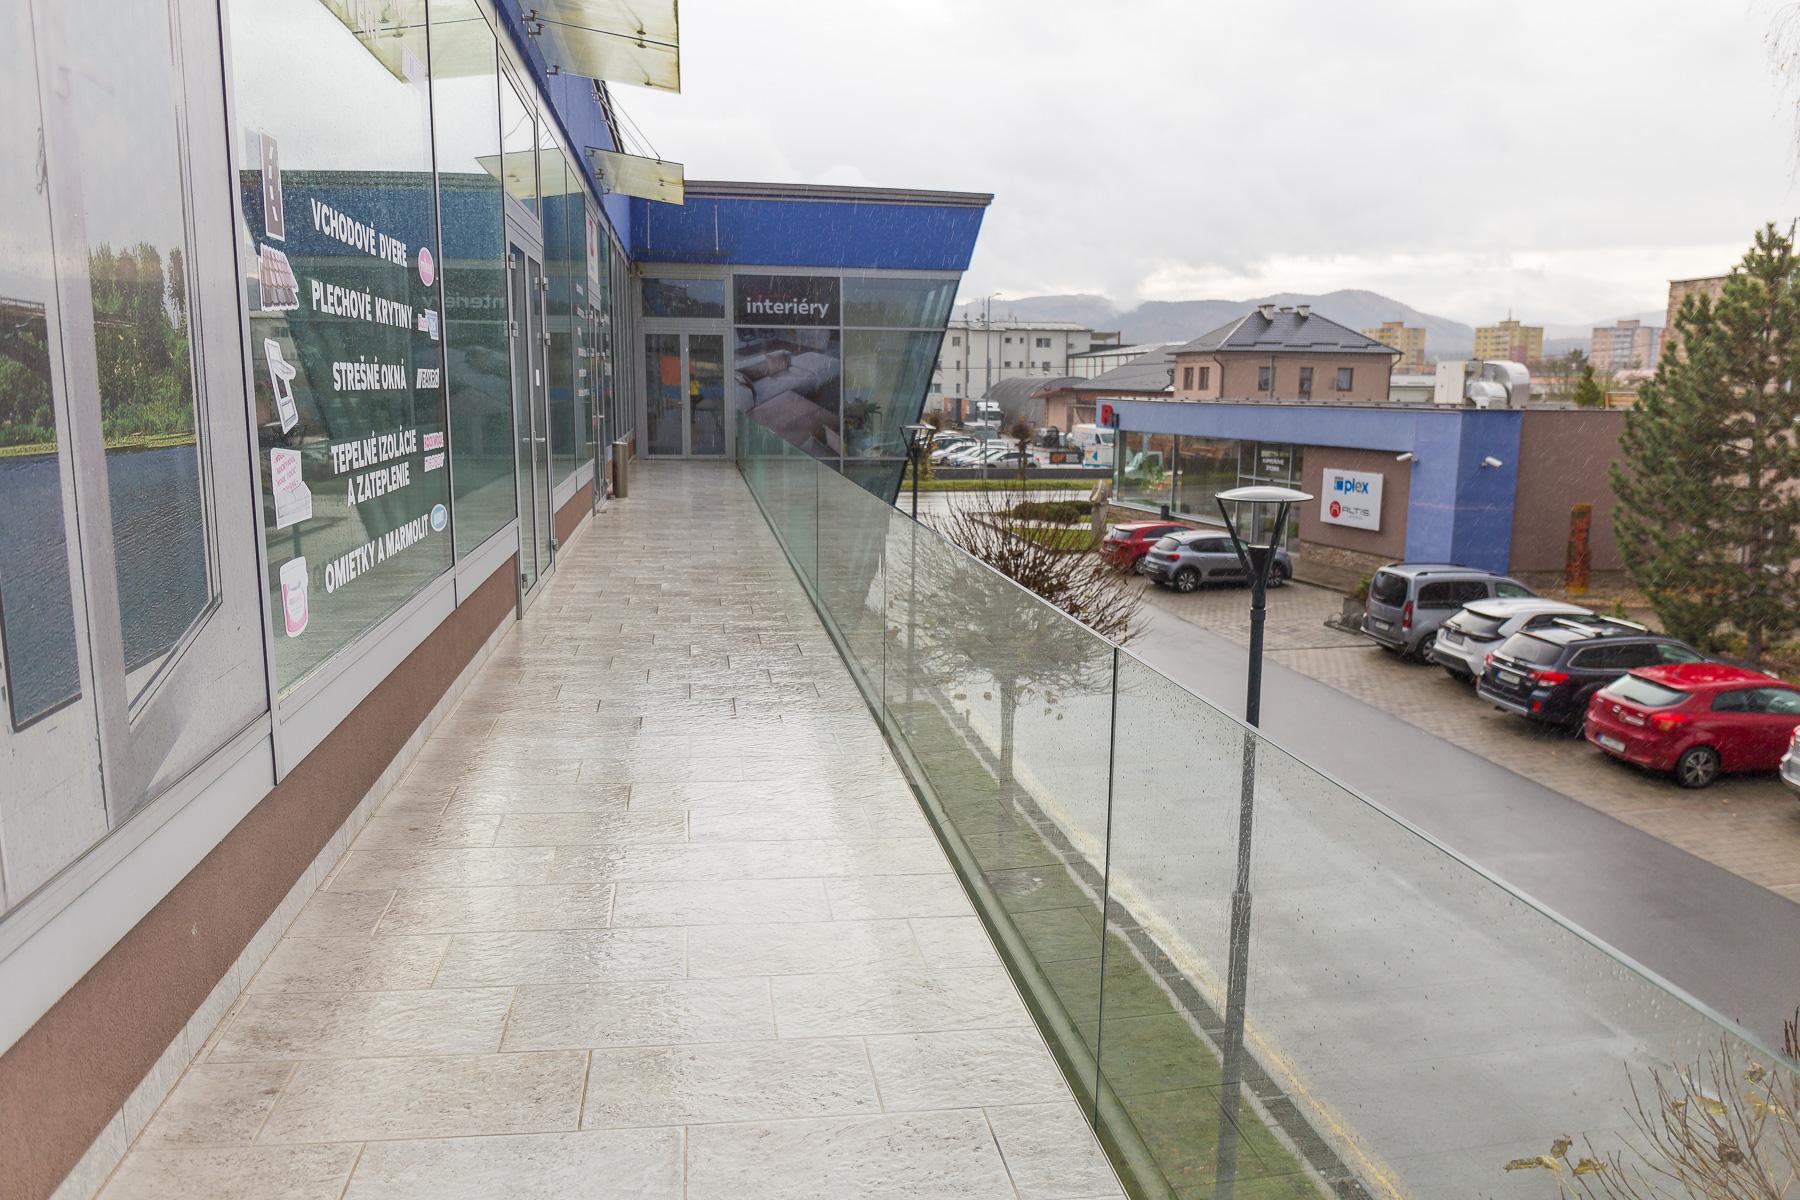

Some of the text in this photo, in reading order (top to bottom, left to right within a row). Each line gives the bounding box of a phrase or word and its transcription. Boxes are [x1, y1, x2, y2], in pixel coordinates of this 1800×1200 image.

[311, 198, 408, 267] VCHODOVÉ DVERE
[312, 279, 372, 321] PLECHOVÉ
[375, 296, 413, 329] KRYTINY
[746, 297, 829, 319] interiéry
[333, 355, 407, 391] STREŠNÉ OKNÁ
[331, 430, 377, 475] TEPELNÉ
[379, 425, 417, 462] IZOLÁCIE
[347, 478, 356, 507] A
[357, 461, 410, 504] ZATEPLENIE
[325, 540, 376, 594] OMIETKY
[377, 537, 385, 563] A
[385, 514, 429, 558] MARMOLIT
